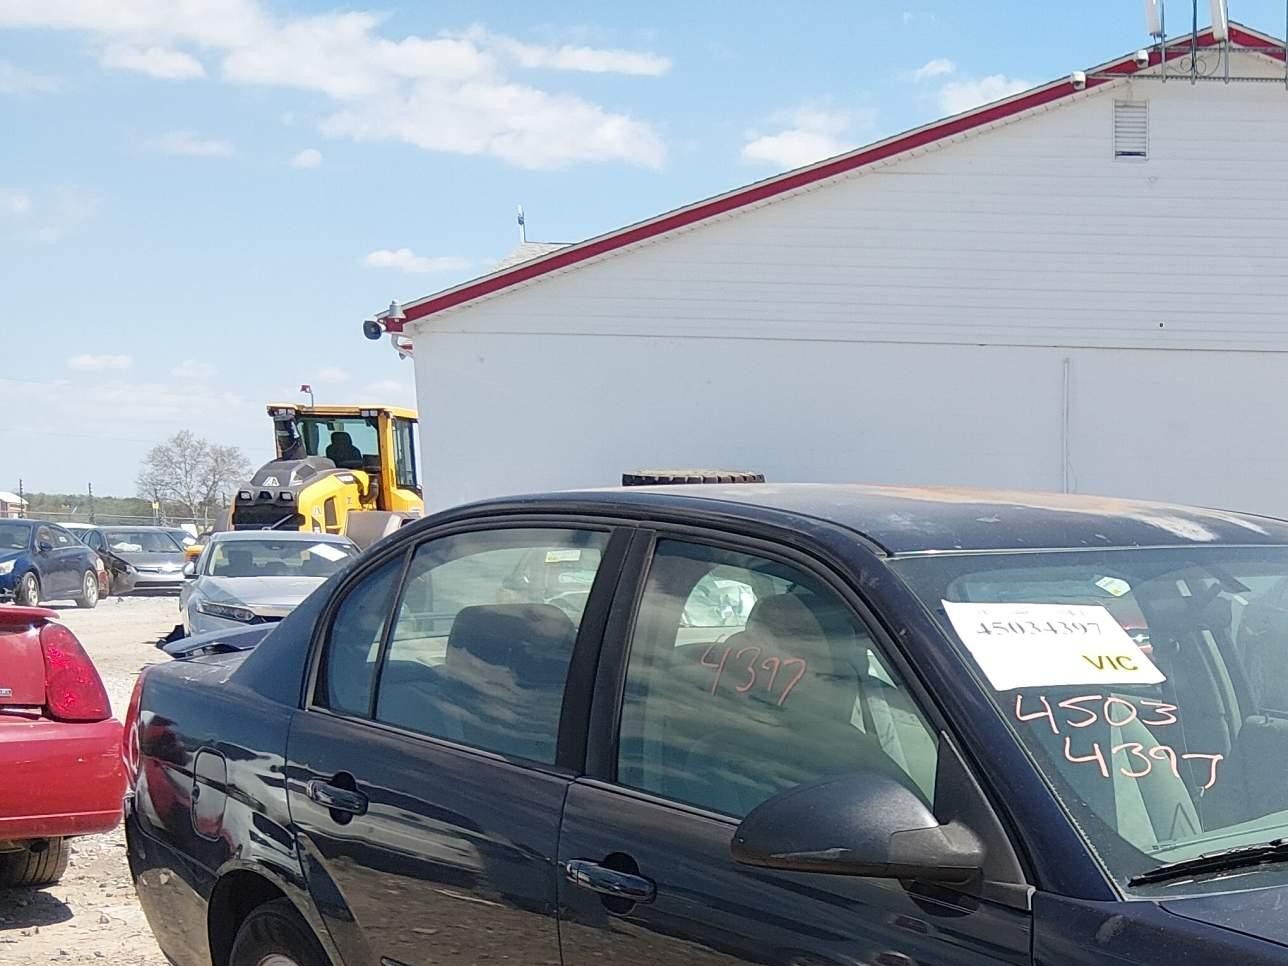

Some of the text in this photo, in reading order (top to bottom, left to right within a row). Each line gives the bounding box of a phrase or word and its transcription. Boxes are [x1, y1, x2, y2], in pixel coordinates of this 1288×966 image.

[700, 633, 807, 707] 4397
[1083, 655, 1138, 671] VIC
[1015, 694, 1178, 735] 4503
[1063, 736, 1224, 791] 4397
